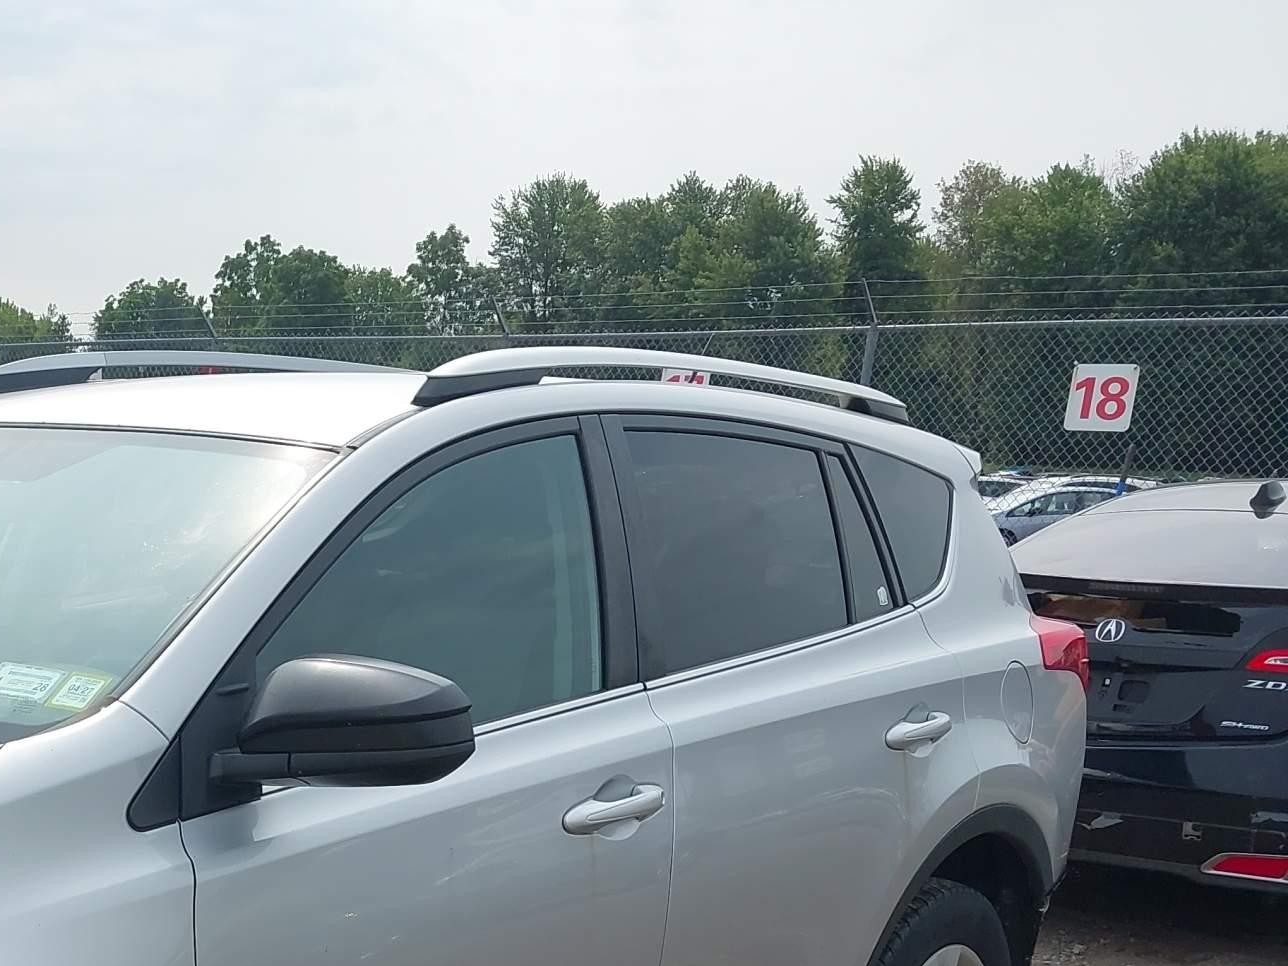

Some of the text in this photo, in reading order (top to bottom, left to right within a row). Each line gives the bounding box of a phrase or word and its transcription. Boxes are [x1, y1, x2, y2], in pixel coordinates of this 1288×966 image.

[1075, 375, 1130, 422] 18
[32, 682, 49, 692] 28
[1242, 679, 1288, 691] ZD
